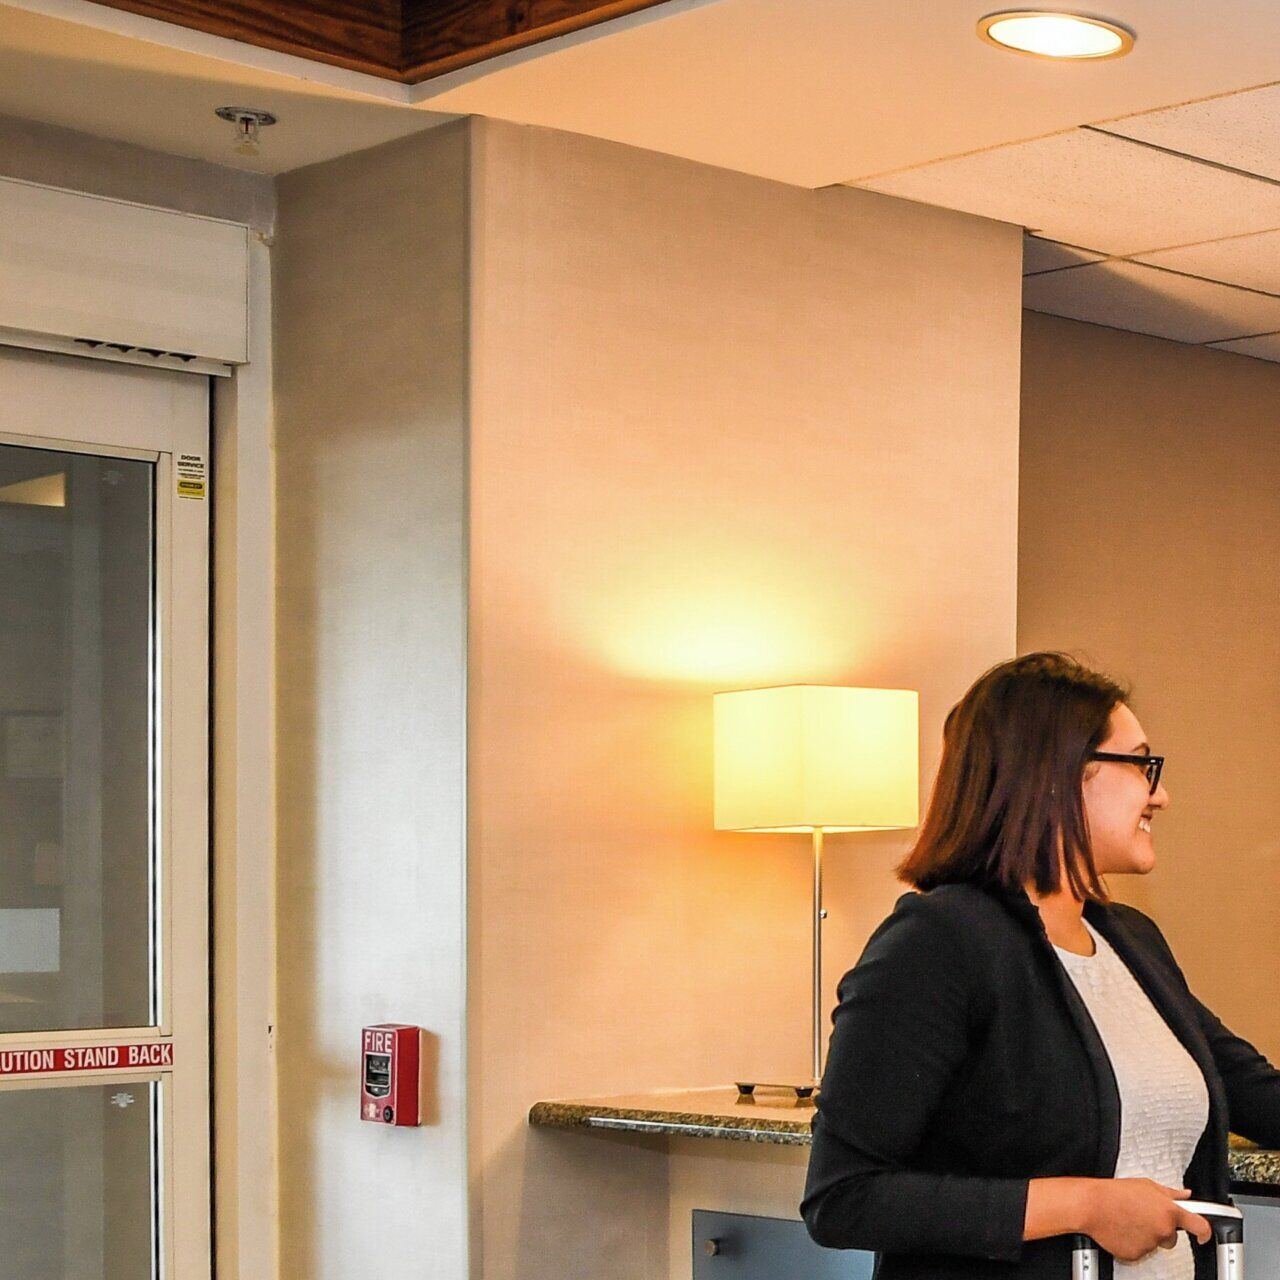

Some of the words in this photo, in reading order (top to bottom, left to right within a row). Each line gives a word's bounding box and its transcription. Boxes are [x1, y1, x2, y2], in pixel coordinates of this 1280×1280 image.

[364, 1031, 393, 1053] FIRE
[0, 1050, 55, 1073] UTION
[64, 1047, 119, 1069] STAND
[128, 1044, 171, 1065] BACK
